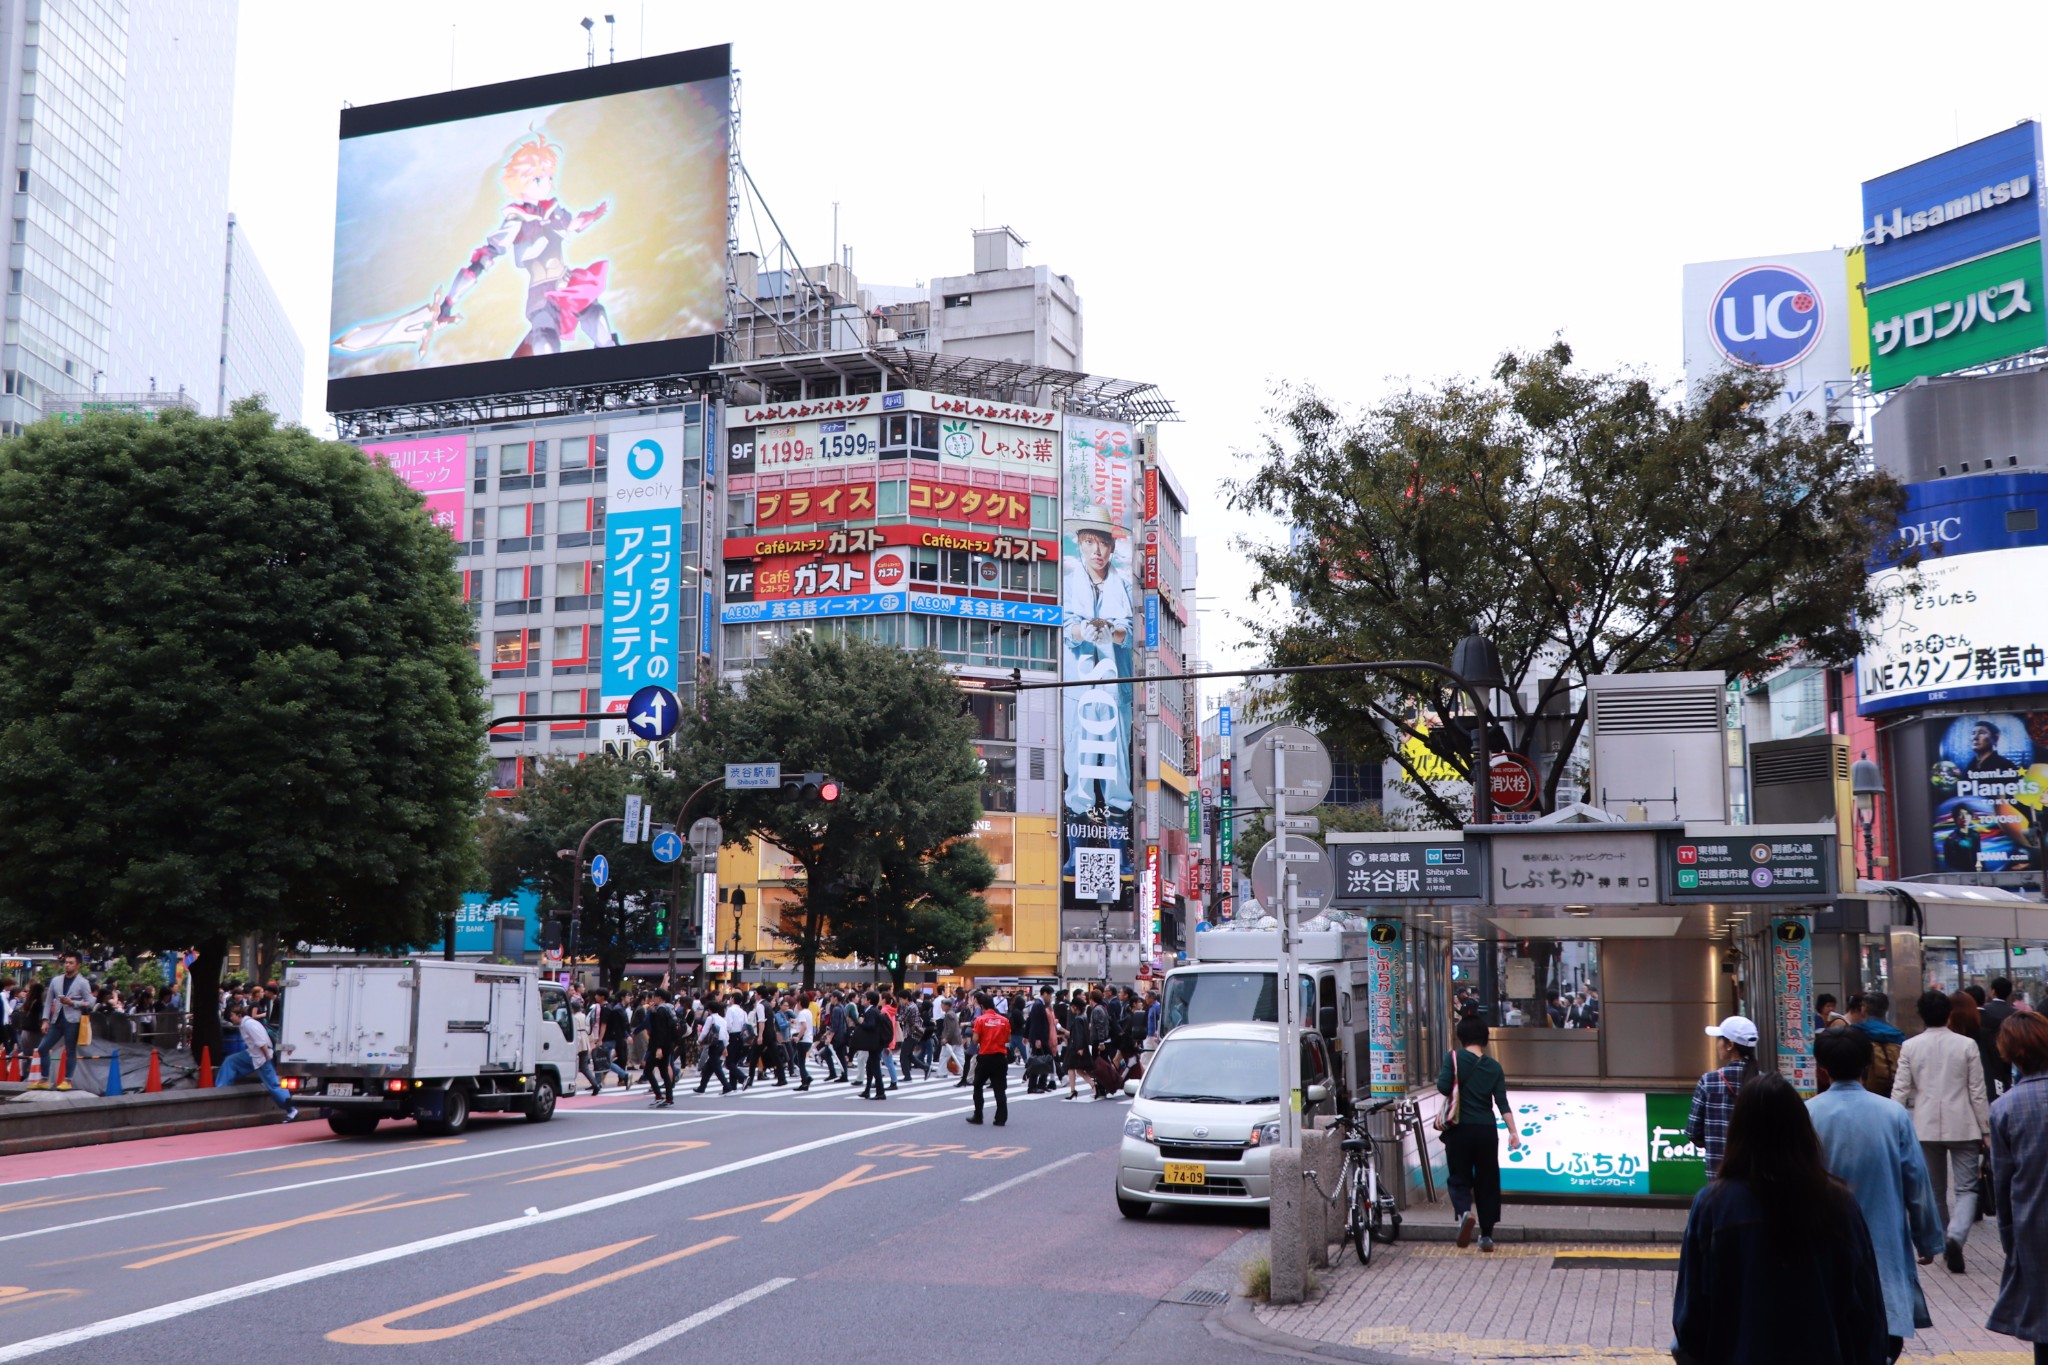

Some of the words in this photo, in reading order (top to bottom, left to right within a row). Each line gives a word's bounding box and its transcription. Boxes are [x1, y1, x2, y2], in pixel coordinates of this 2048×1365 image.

[1861, 175, 2031, 246] Hisamitsu
[1872, 278, 2032, 356] サロンパス
[745, 397, 870, 422] しゃぶしゃぶバイキング
[932, 396, 1055, 426] しゃぶしゃぶバイキング
[732, 443, 753, 459] 9F
[981, 431, 1053, 463] しゃぶ葉
[1090, 429, 1110, 506] Sazabys
[617, 484, 672, 501] eyecity
[1111, 463, 1128, 539] Limited
[758, 485, 874, 520] プライス
[910, 485, 1028, 523] コンタクト
[1899, 517, 1962, 549] DHC
[755, 539, 825, 555] Caféレストラン
[828, 529, 885, 553] ガスト
[922, 533, 990, 551] Caféレストラン
[993, 537, 1047, 562] ガスト
[760, 570, 790, 585] Café
[878, 568, 901, 577] ガスト
[1148, 556, 1156, 583] ガスト
[727, 573, 753, 592] 7F
[794, 563, 864, 596] ガスト
[612, 527, 645, 681] アイシティ
[648, 525, 671, 679] コンタクトの
[882, 597, 898, 608] 6F
[916, 597, 949, 609] AEON
[1914, 590, 1977, 610] どうしたら
[727, 605, 760, 618] AEON
[772, 600, 875, 618] 英会話イーオン
[960, 599, 1059, 622] 英会話イーオン
[1928, 690, 1948, 701] DHC
[730, 767, 776, 779] 渋谷駅前
[1968, 768, 2017, 779] teamLab
[1490, 775, 1527, 792] 消火栓
[1957, 778, 2040, 797] Planets
[1979, 815, 2022, 824] TOYOSU
[1066, 824, 1129, 840] 10月10日発売
[1368, 853, 1410, 862] 東急電鉄
[1569, 853, 1626, 861] ショッピングロード
[1698, 845, 1728, 855] 東横線
[1772, 844, 1813, 854] 副都心線
[1347, 869, 1420, 893] 渋谷駅
[1425, 868, 1454, 877] Shibuya
[1456, 868, 1470, 876] Sta.
[1501, 867, 1594, 890] しぶちか
[1598, 877, 1649, 888] 神南口
[1682, 874, 1694, 882] DT
[1698, 869, 1749, 879] 田園都市線
[1773, 868, 1815, 878] 半蔵門線
[1223, 871, 1231, 914] HOOERS
[1378, 928, 1388, 941] 7
[1785, 926, 1796, 939] 7
[1546, 1152, 1641, 1175] しぶちか
[1173, 1171, 1203, 1183] 74-09
[1570, 1178, 1636, 1186] ショッピングロード
